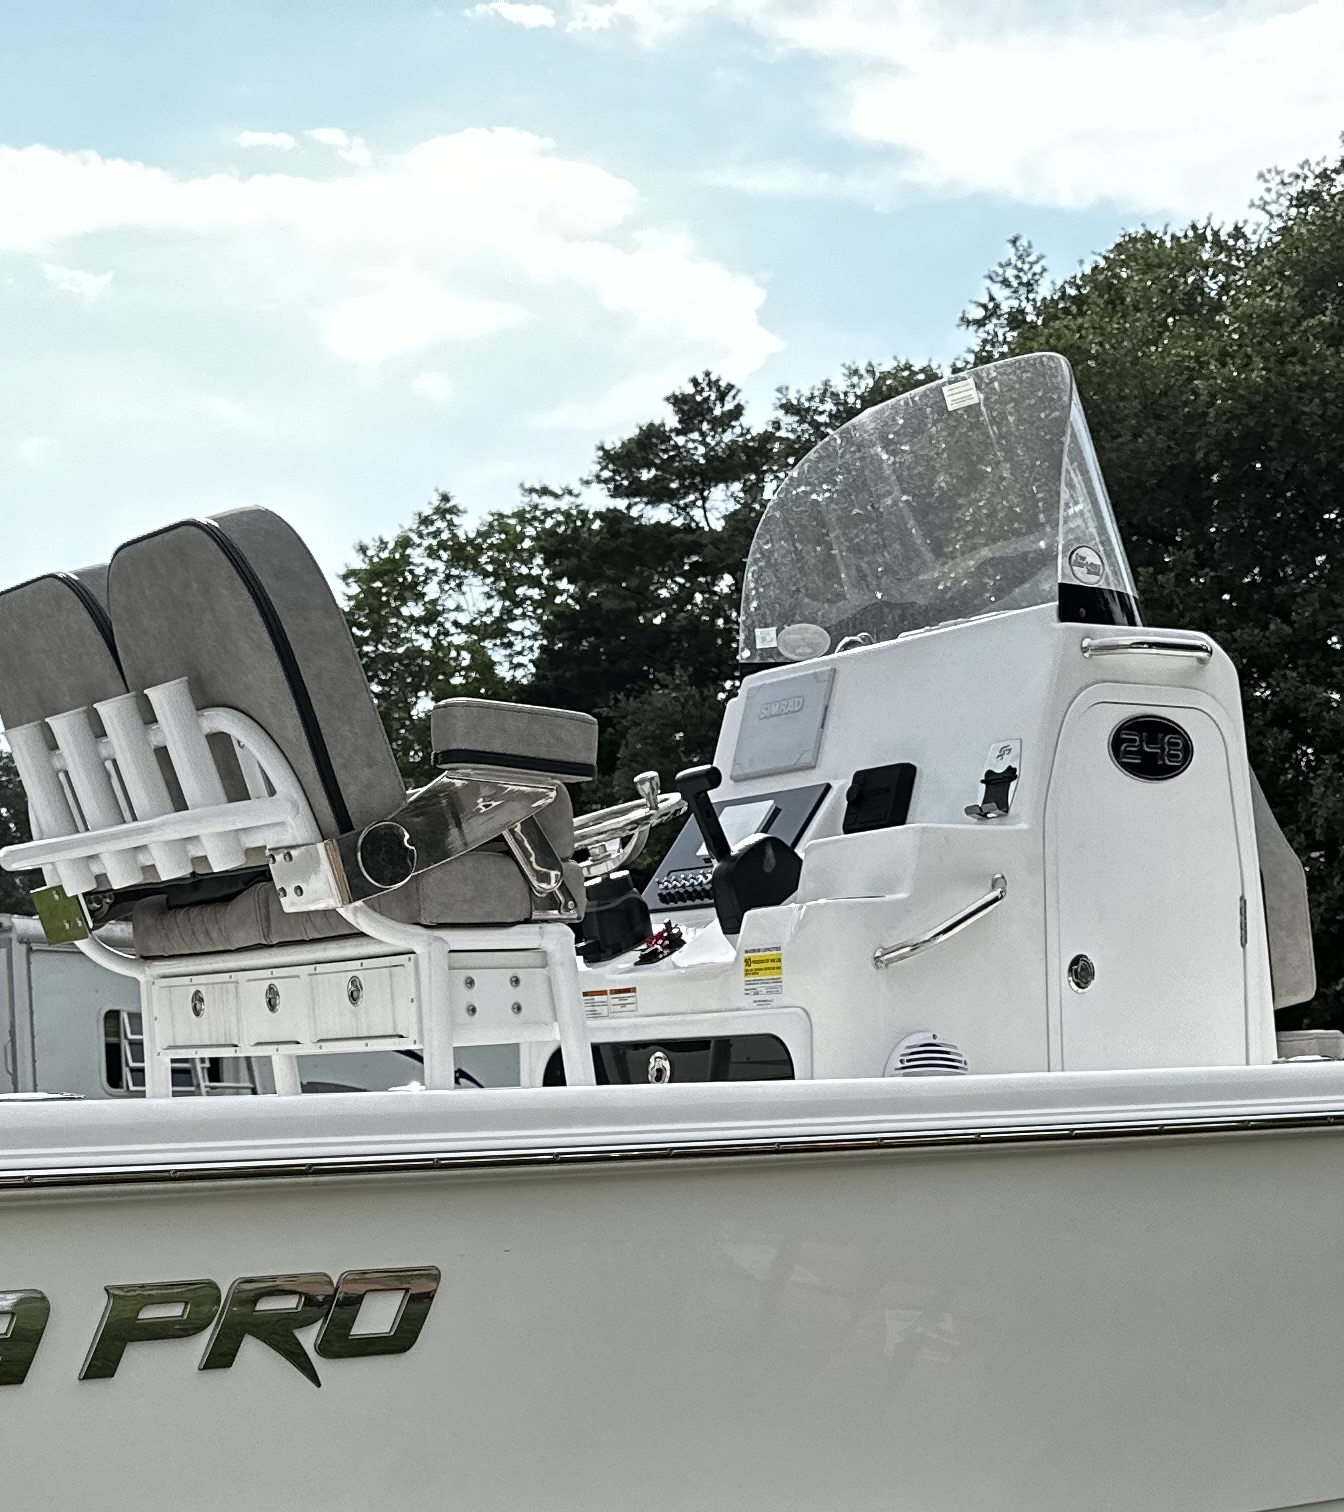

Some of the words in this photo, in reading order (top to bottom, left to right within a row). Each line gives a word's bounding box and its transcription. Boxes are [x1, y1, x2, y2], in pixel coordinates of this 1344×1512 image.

[759, 696, 805, 720] SIMRAD
[1119, 730, 1184, 766] 248
[78, 1265, 442, 1388] PRO
